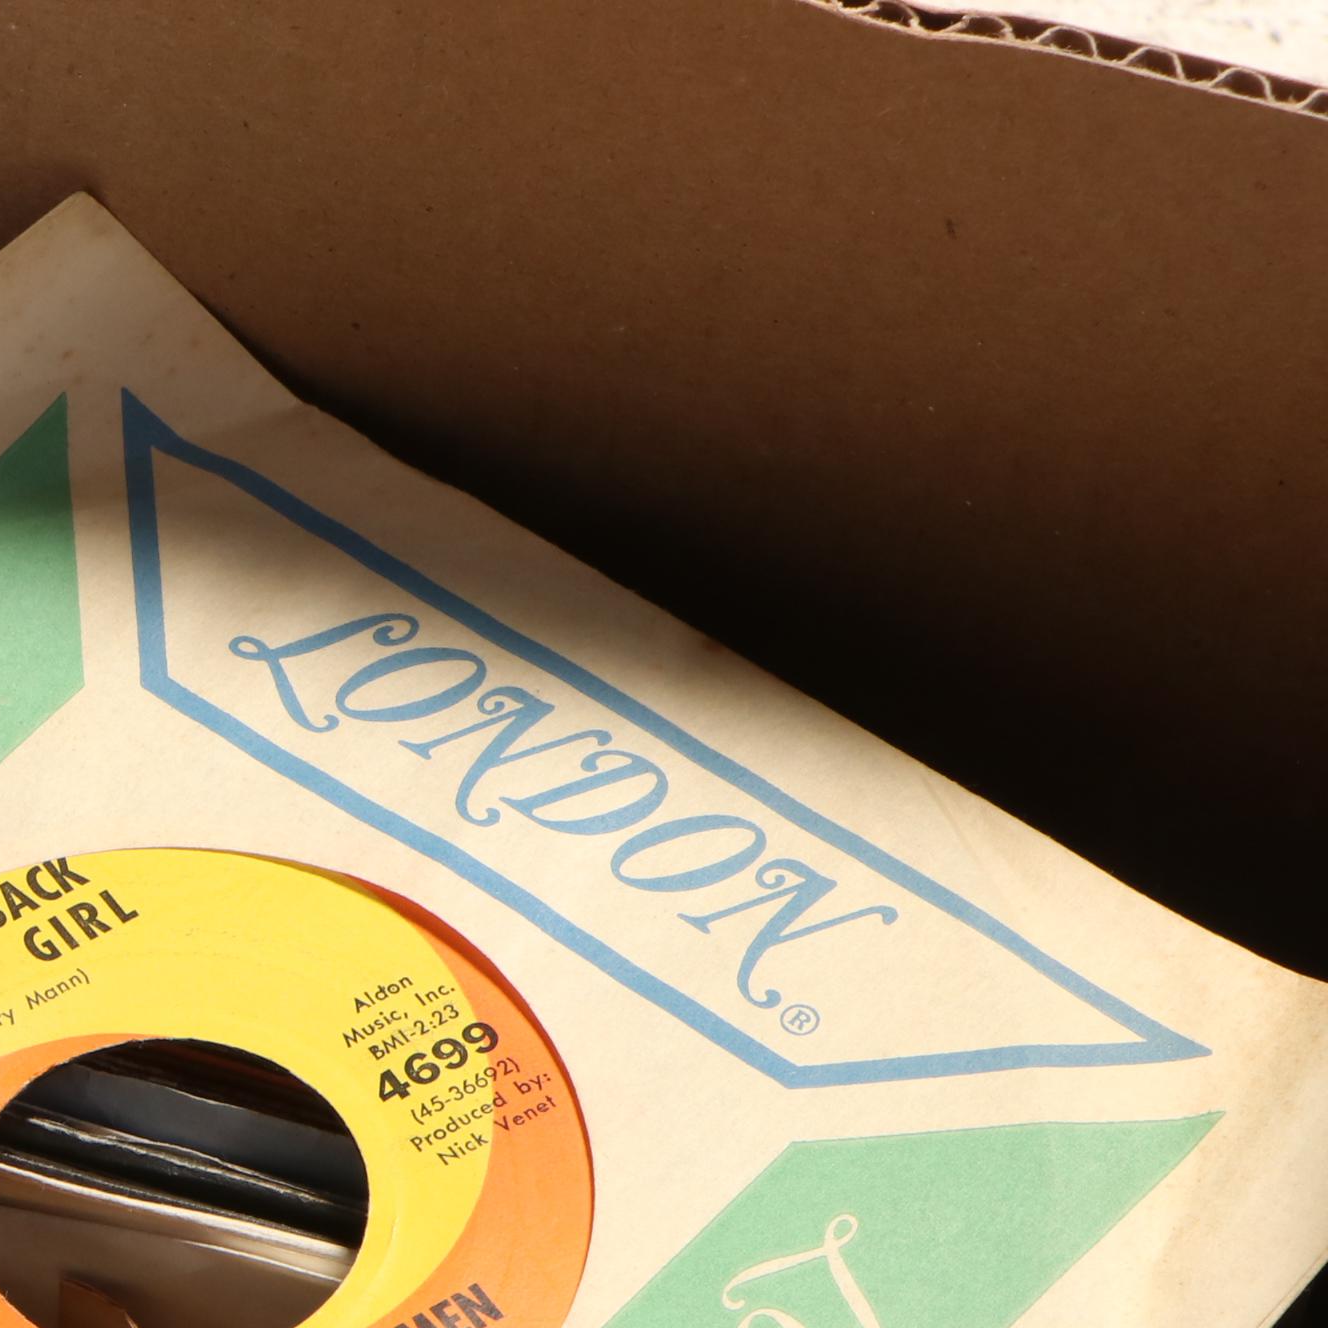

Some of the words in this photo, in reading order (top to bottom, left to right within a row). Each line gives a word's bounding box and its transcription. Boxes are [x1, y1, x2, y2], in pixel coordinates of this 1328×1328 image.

[228, 612, 898, 1010] LONDON
[23, 889, 140, 963] GIRL
[25, 968, 91, 1011] Mann)
[342, 1010, 409, 1048] Music,
[414, 984, 456, 1006] Inc.
[353, 975, 414, 1014] Aldon
[368, 1004, 460, 1061] BMI-2:23
[377, 1022, 499, 1103] 4699
[409, 1091, 507, 1152] Produced
[513, 1072, 552, 1096] by:
[410, 1057, 521, 1125] (45-36692)
[436, 1132, 489, 1166] Nick
[493, 1095, 558, 1132] Venet
